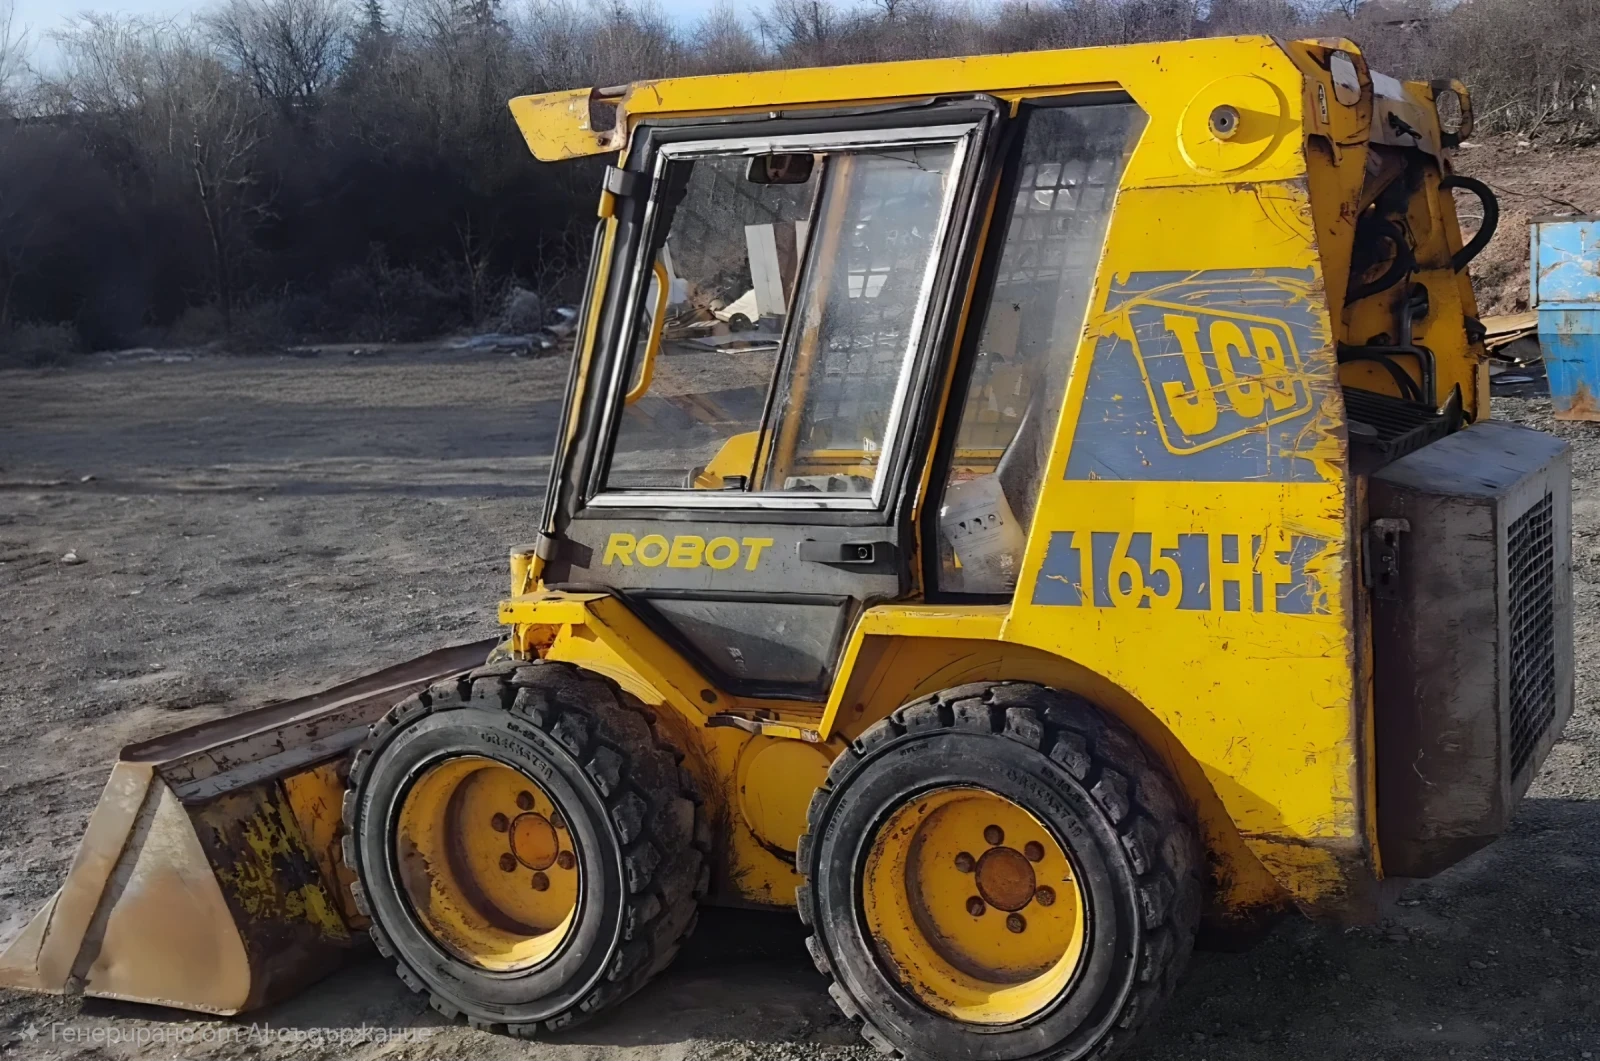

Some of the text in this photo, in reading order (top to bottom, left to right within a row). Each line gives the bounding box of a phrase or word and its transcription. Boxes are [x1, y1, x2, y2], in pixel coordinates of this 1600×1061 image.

[1162, 313, 1297, 436] JCB
[602, 532, 774, 571] ROBOT
[1069, 530, 1292, 613] 165 HF
